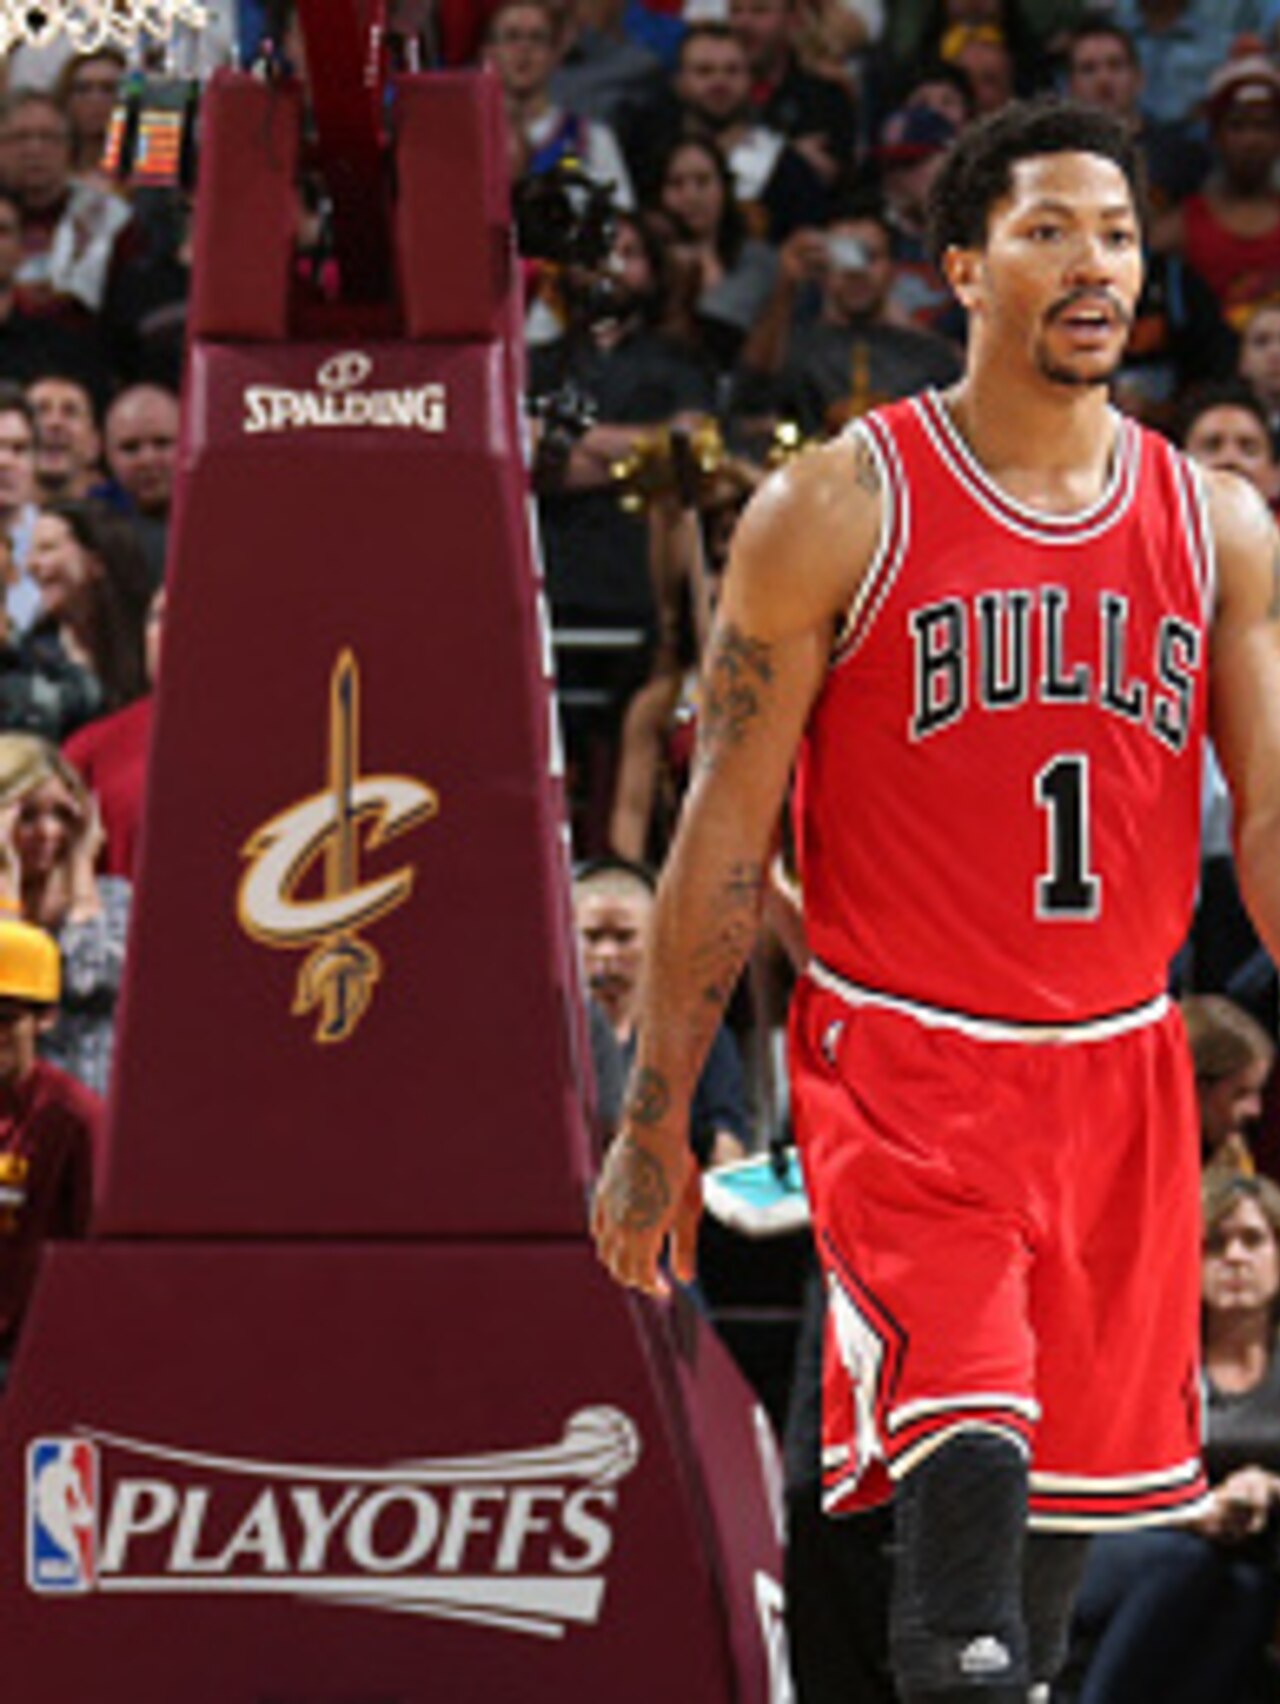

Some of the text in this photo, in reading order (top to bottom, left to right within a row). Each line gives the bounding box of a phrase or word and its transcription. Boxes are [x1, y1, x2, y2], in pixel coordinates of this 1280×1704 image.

[244, 383, 446, 432] SPALDING
[908, 582, 1202, 756] BULLS
[1034, 752, 1101, 922] 1
[100, 1479, 616, 1574] PLAYOFFS
